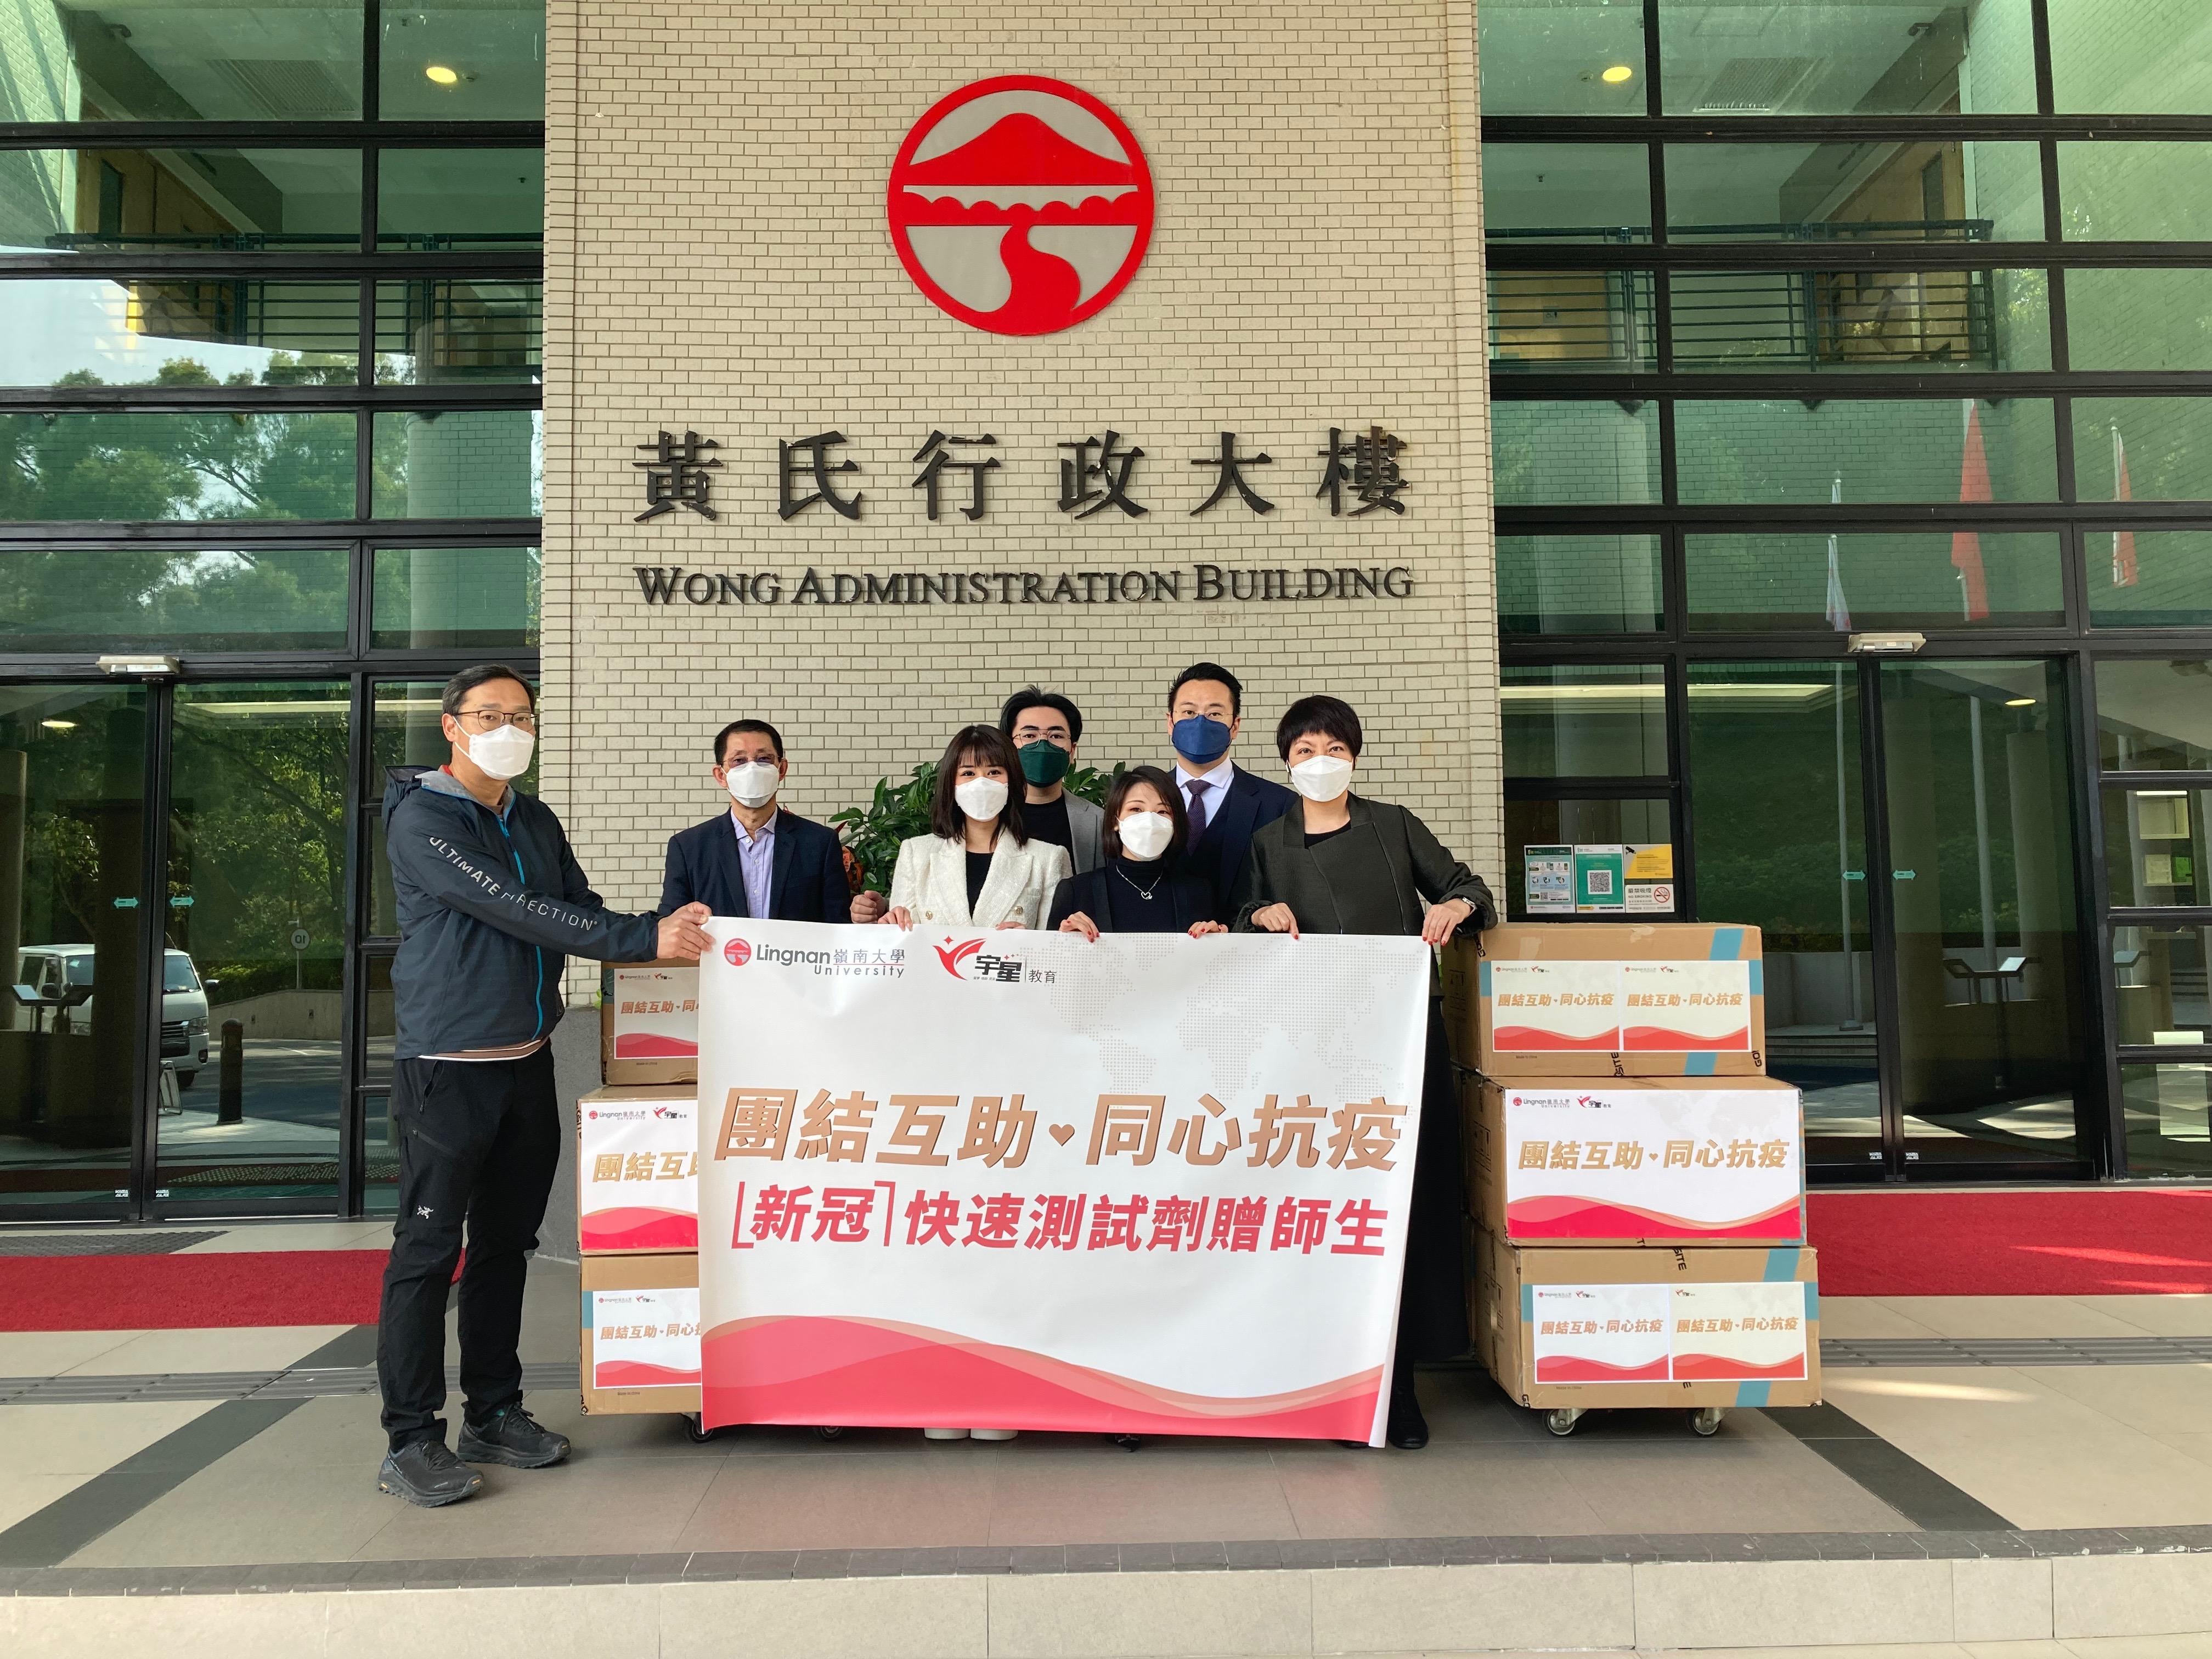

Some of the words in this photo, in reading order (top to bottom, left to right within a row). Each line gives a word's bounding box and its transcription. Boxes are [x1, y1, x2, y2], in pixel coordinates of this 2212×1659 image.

[632, 426, 1410, 522] 黃氏行政大樓
[632, 566, 781, 605] WONG
[790, 566, 1181, 605] ADMINISTRATION
[1193, 564, 1414, 601] BUILDING
[428, 836, 501, 896] ULTIMATE
[756, 944, 830, 967] Lingnan
[833, 948, 905, 964] 嶺南大學
[814, 964, 905, 978] University
[1028, 969, 1057, 984] 教育
[620, 1000, 674, 1014] 團結互助
[682, 1000, 699, 1012] 同
[1497, 994, 1552, 1006] 團結互助
[1559, 992, 1615, 1006] 同心抗疫
[1627, 994, 1681, 1006] 團結互助
[1689, 992, 1743, 1006] 同心抗疫
[713, 1087, 1038, 1169] 團結互助
[1085, 1093, 1408, 1171] 同心抗疫
[1517, 1140, 1644, 1171] 團結互助
[1663, 1138, 1790, 1169] 同心抗疫
[600, 1324, 658, 1340] 團結互助
[1541, 1321, 1598, 1335] 團結互助
[1606, 1318, 1664, 1333] 同心抗疫
[1676, 1318, 1734, 1333] 團結互助
[1741, 1317, 1799, 1331] 同心抗疫
